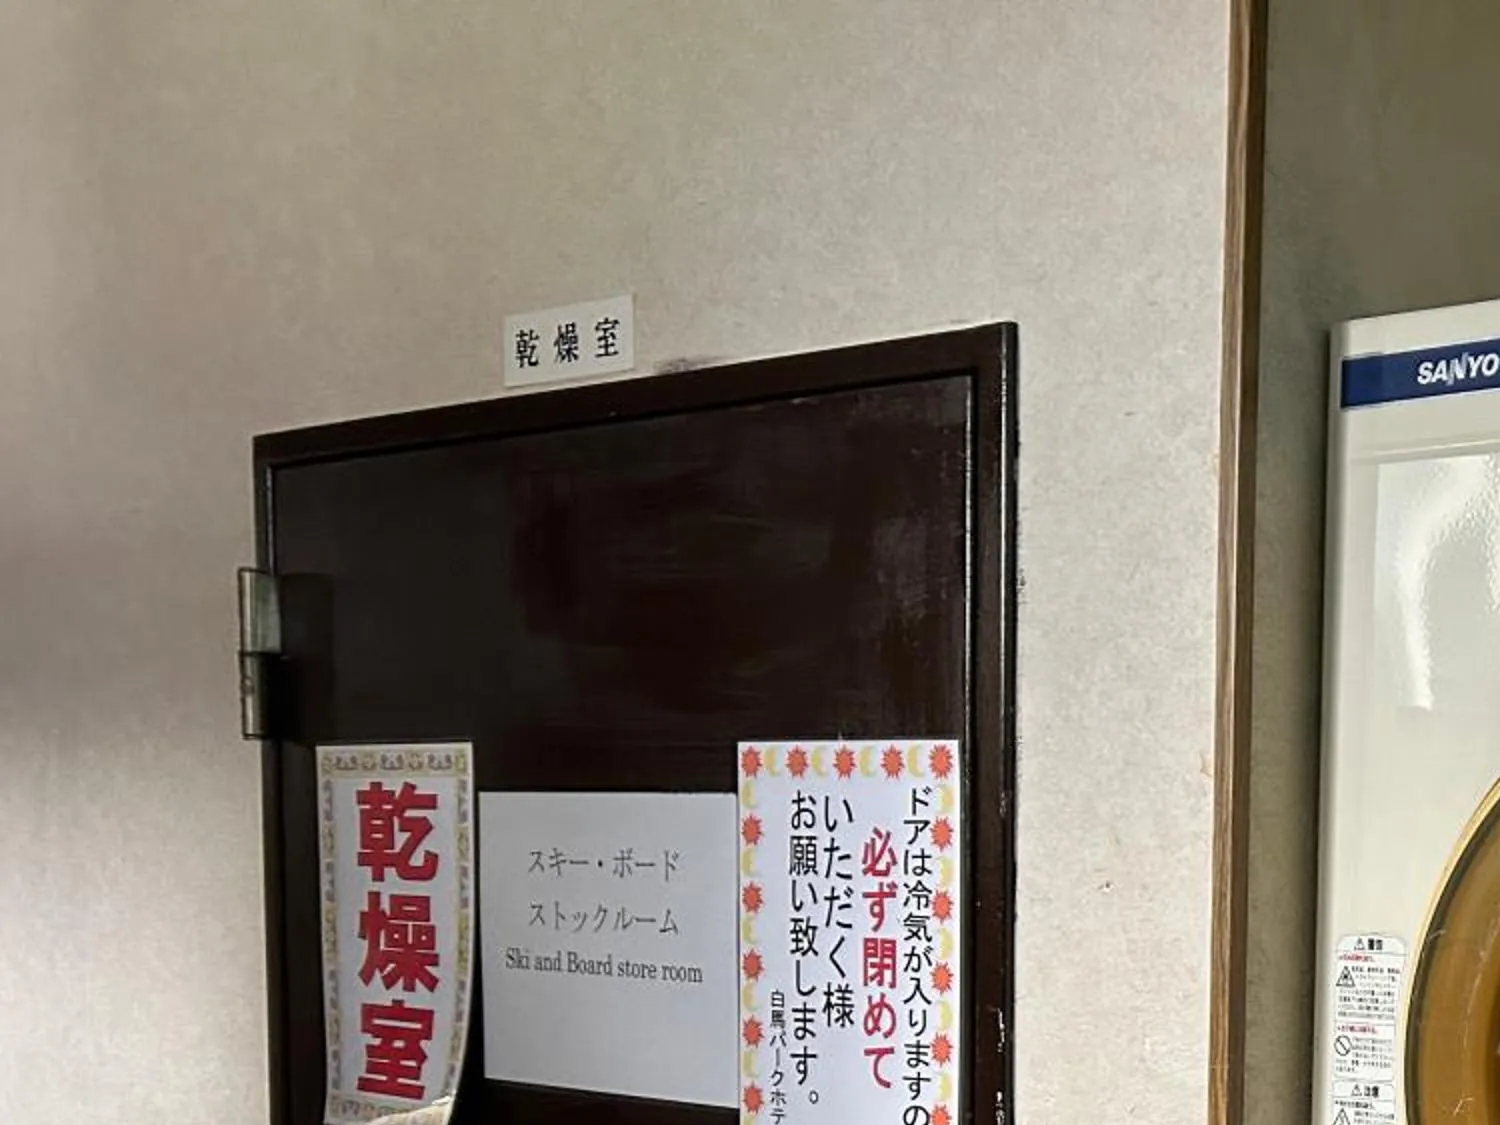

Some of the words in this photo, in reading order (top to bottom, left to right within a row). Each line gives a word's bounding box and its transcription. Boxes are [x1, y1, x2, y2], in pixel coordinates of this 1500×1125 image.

[515, 317, 620, 369] 乾燥室
[1417, 352, 1500, 386] SANYO
[528, 847, 681, 881] スキー・ボード
[529, 902, 679, 936] ストックルーム
[822, 795, 856, 1030] いただく様
[355, 781, 440, 1101] 乾燥室
[505, 947, 529, 970] Ski
[534, 951, 562, 972] and
[567, 951, 613, 977] Board
[617, 959, 657, 979] store
[661, 963, 704, 983] room
[789, 790, 820, 1106] お願い致します。
[861, 826, 898, 1090] 必ず閉めて
